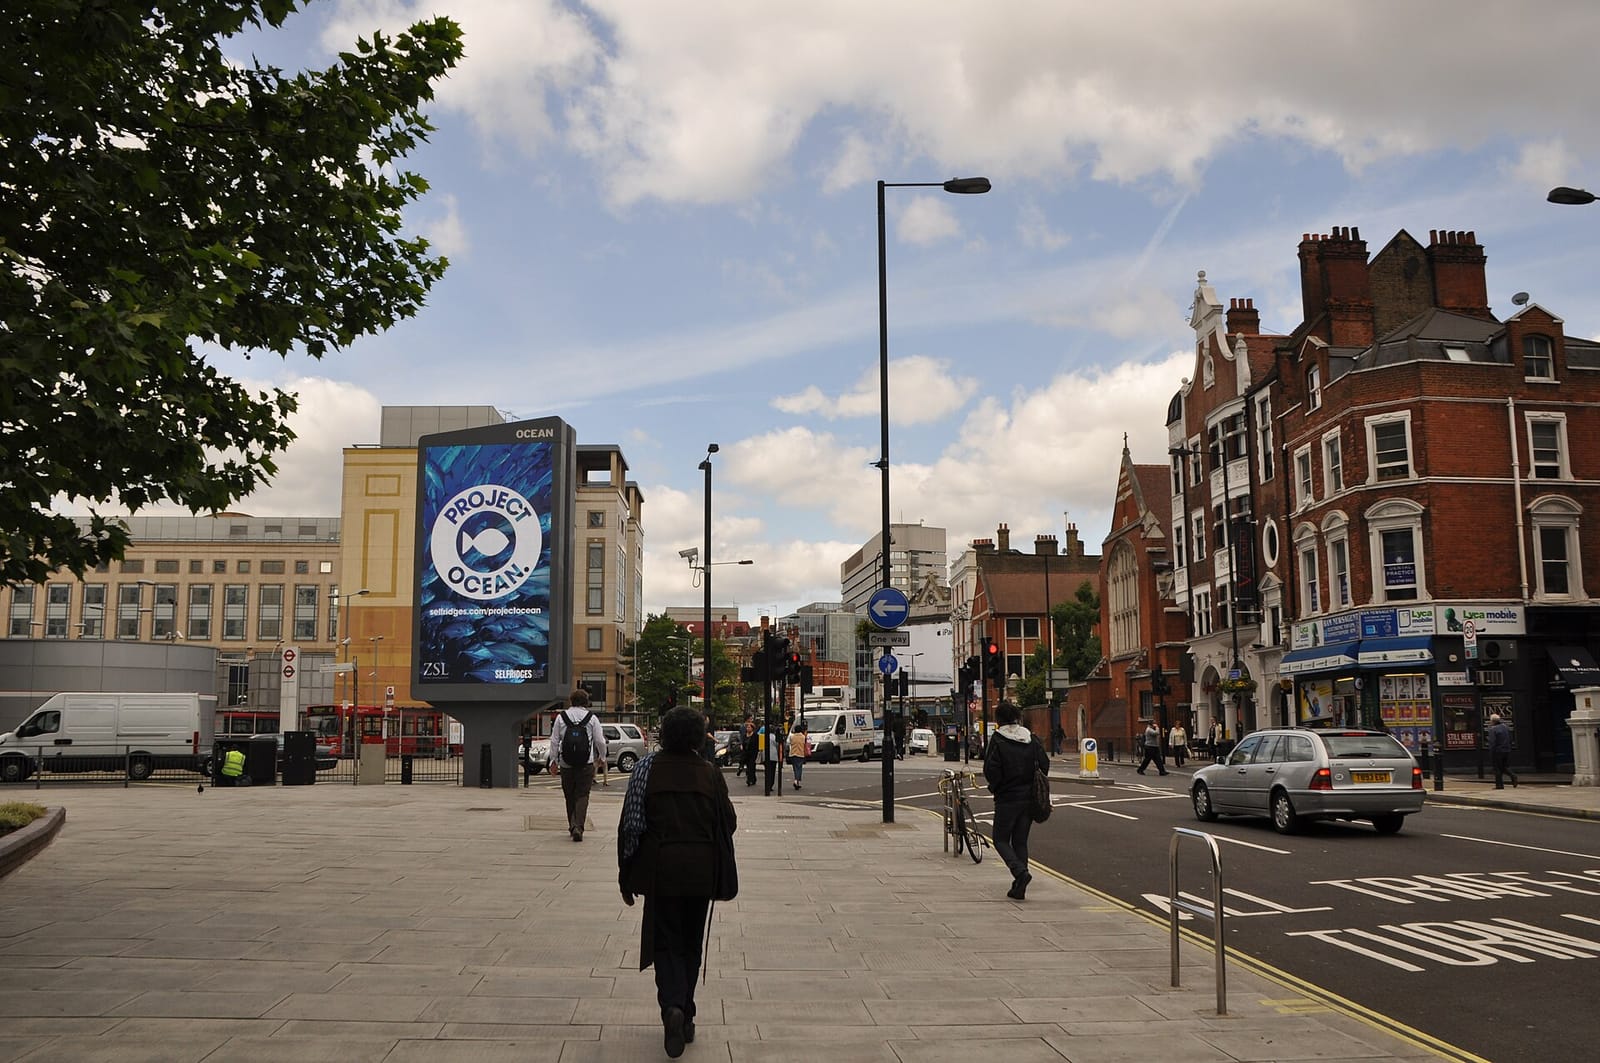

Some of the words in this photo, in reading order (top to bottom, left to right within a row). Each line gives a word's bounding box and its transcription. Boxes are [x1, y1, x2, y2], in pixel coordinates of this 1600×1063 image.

[516, 428, 554, 439] OCEAN
[444, 489, 532, 525] PROJECT
[429, 606, 541, 618] selfridges.com/projectocean
[1412, 610, 1433, 619] Lyca
[1463, 610, 1485, 619] Lyca
[1486, 610, 1517, 619] mobile
[871, 635, 887, 643] One
[891, 636, 907, 644] way
[424, 662, 449, 676] ZSL
[494, 669, 533, 679] SELFRIDGES
[1482, 705, 1514, 717] INXS
[1447, 733, 1460, 741] STILL
[1461, 733, 1475, 741] HERE
[1141, 888, 1334, 920] ALL
[1284, 917, 1600, 972] TURN
